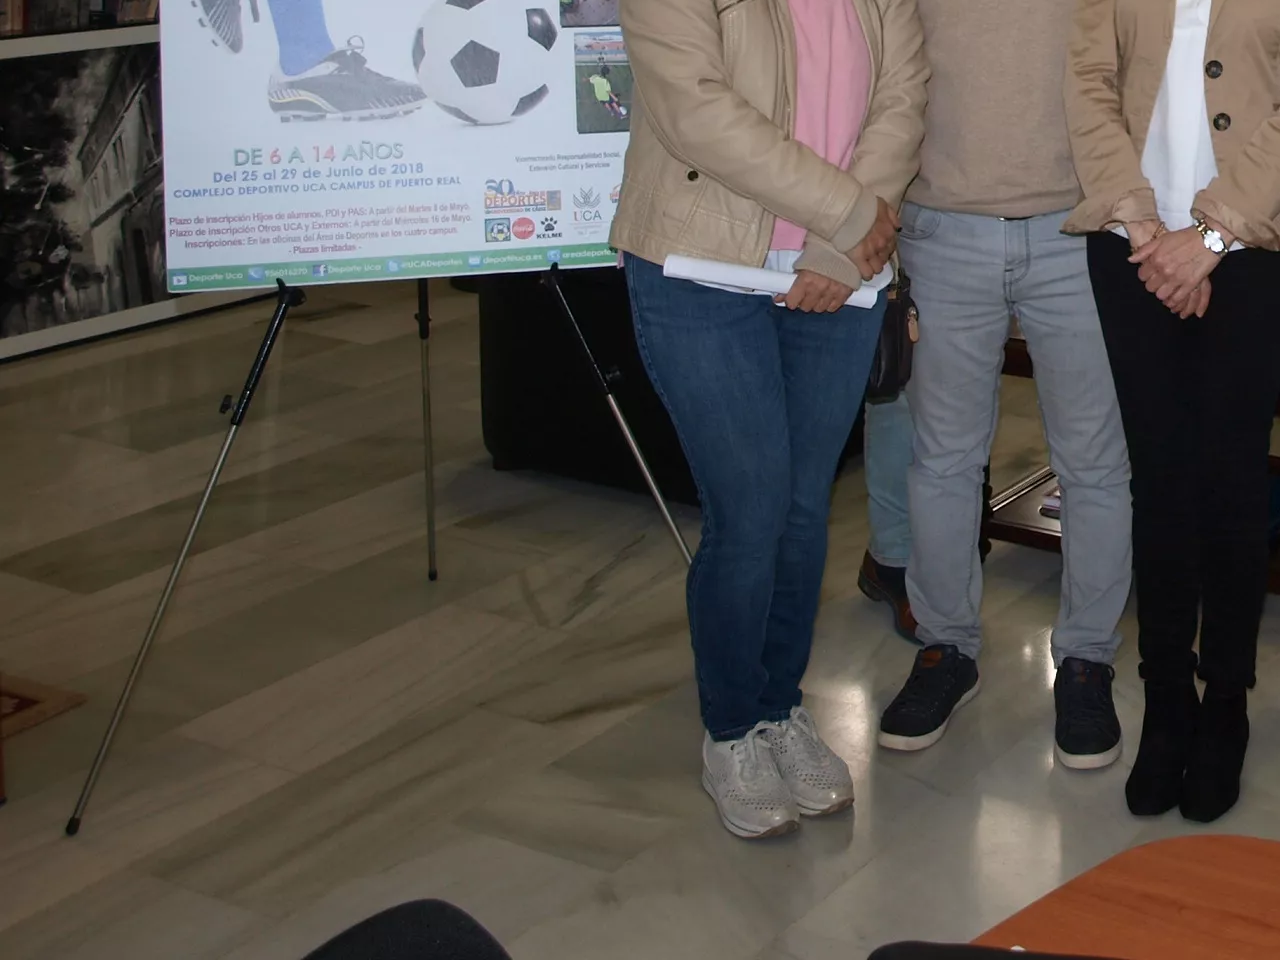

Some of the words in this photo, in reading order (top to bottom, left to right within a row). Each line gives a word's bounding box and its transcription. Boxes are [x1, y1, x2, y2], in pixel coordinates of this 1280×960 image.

[233, 149, 262, 166] DE
[269, 148, 281, 164] 6
[287, 147, 304, 164] A
[312, 146, 335, 163] 14
[341, 141, 403, 161] AÑOS
[212, 171, 236, 183] Del
[241, 170, 258, 182] 25
[262, 169, 276, 181] al
[280, 168, 297, 180] 29
[302, 168, 321, 179] de
[325, 166, 363, 178] Junio
[368, 165, 386, 176] de
[390, 162, 423, 174] 2018
[172, 186, 234, 198] COMPLEJO
[237, 183, 299, 195] DEPORTIVO
[302, 182, 326, 192] UCA
[329, 180, 375, 191] CAMPUS
[378, 179, 391, 188] DE
[394, 177, 433, 187] PUERTO
[436, 176, 461, 186] REAL
[485, 194, 546, 209] DEPORTES
[573, 210, 602, 222] UCA
[536, 231, 562, 239] KELME
